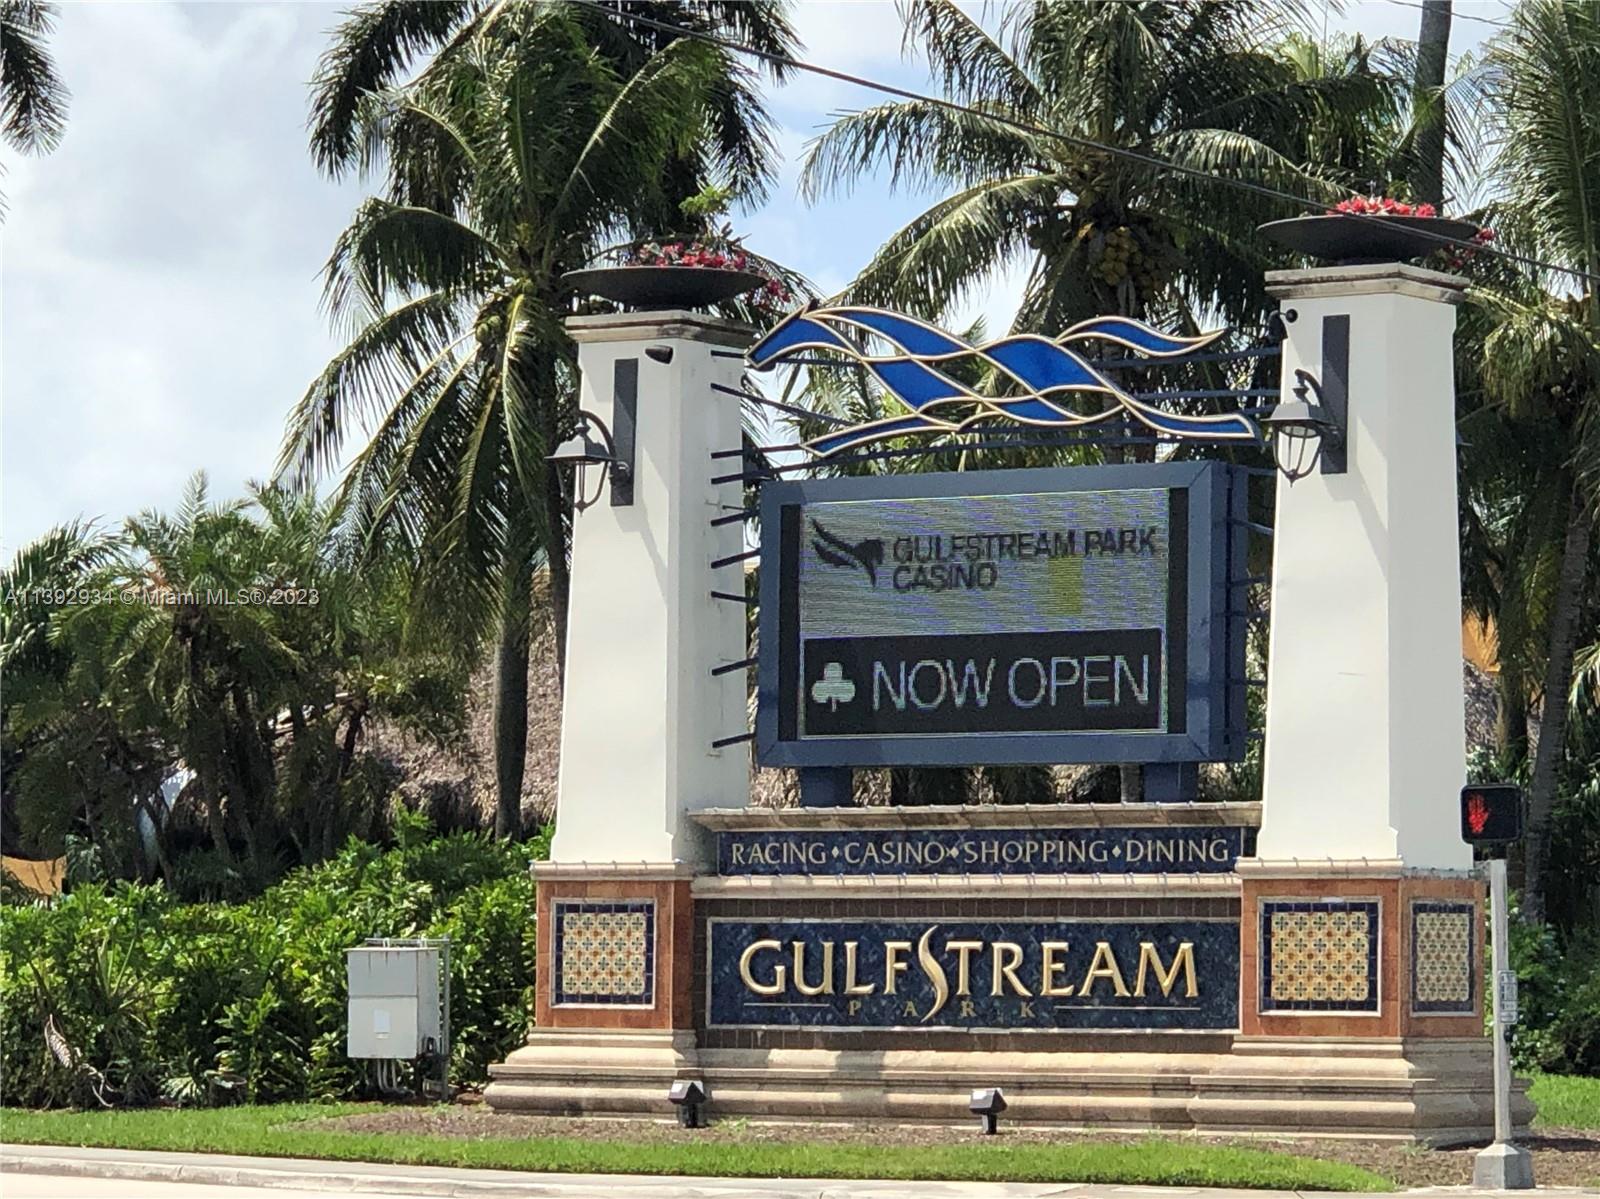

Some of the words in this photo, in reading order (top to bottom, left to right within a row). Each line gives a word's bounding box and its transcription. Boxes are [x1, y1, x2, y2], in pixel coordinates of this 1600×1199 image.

[893, 530, 1075, 563] GULFSTREAM
[1084, 527, 1156, 556] PARK
[893, 562, 998, 592] CASINO
[872, 657, 995, 711] NOW
[1008, 654, 1148, 708] OPEN
[731, 842, 827, 864] RACING
[844, 842, 946, 863] CASINO
[965, 840, 1109, 863] SHOPPING
[1126, 839, 1229, 862] DINING
[738, 925, 1200, 1022] GULFSTREAM
